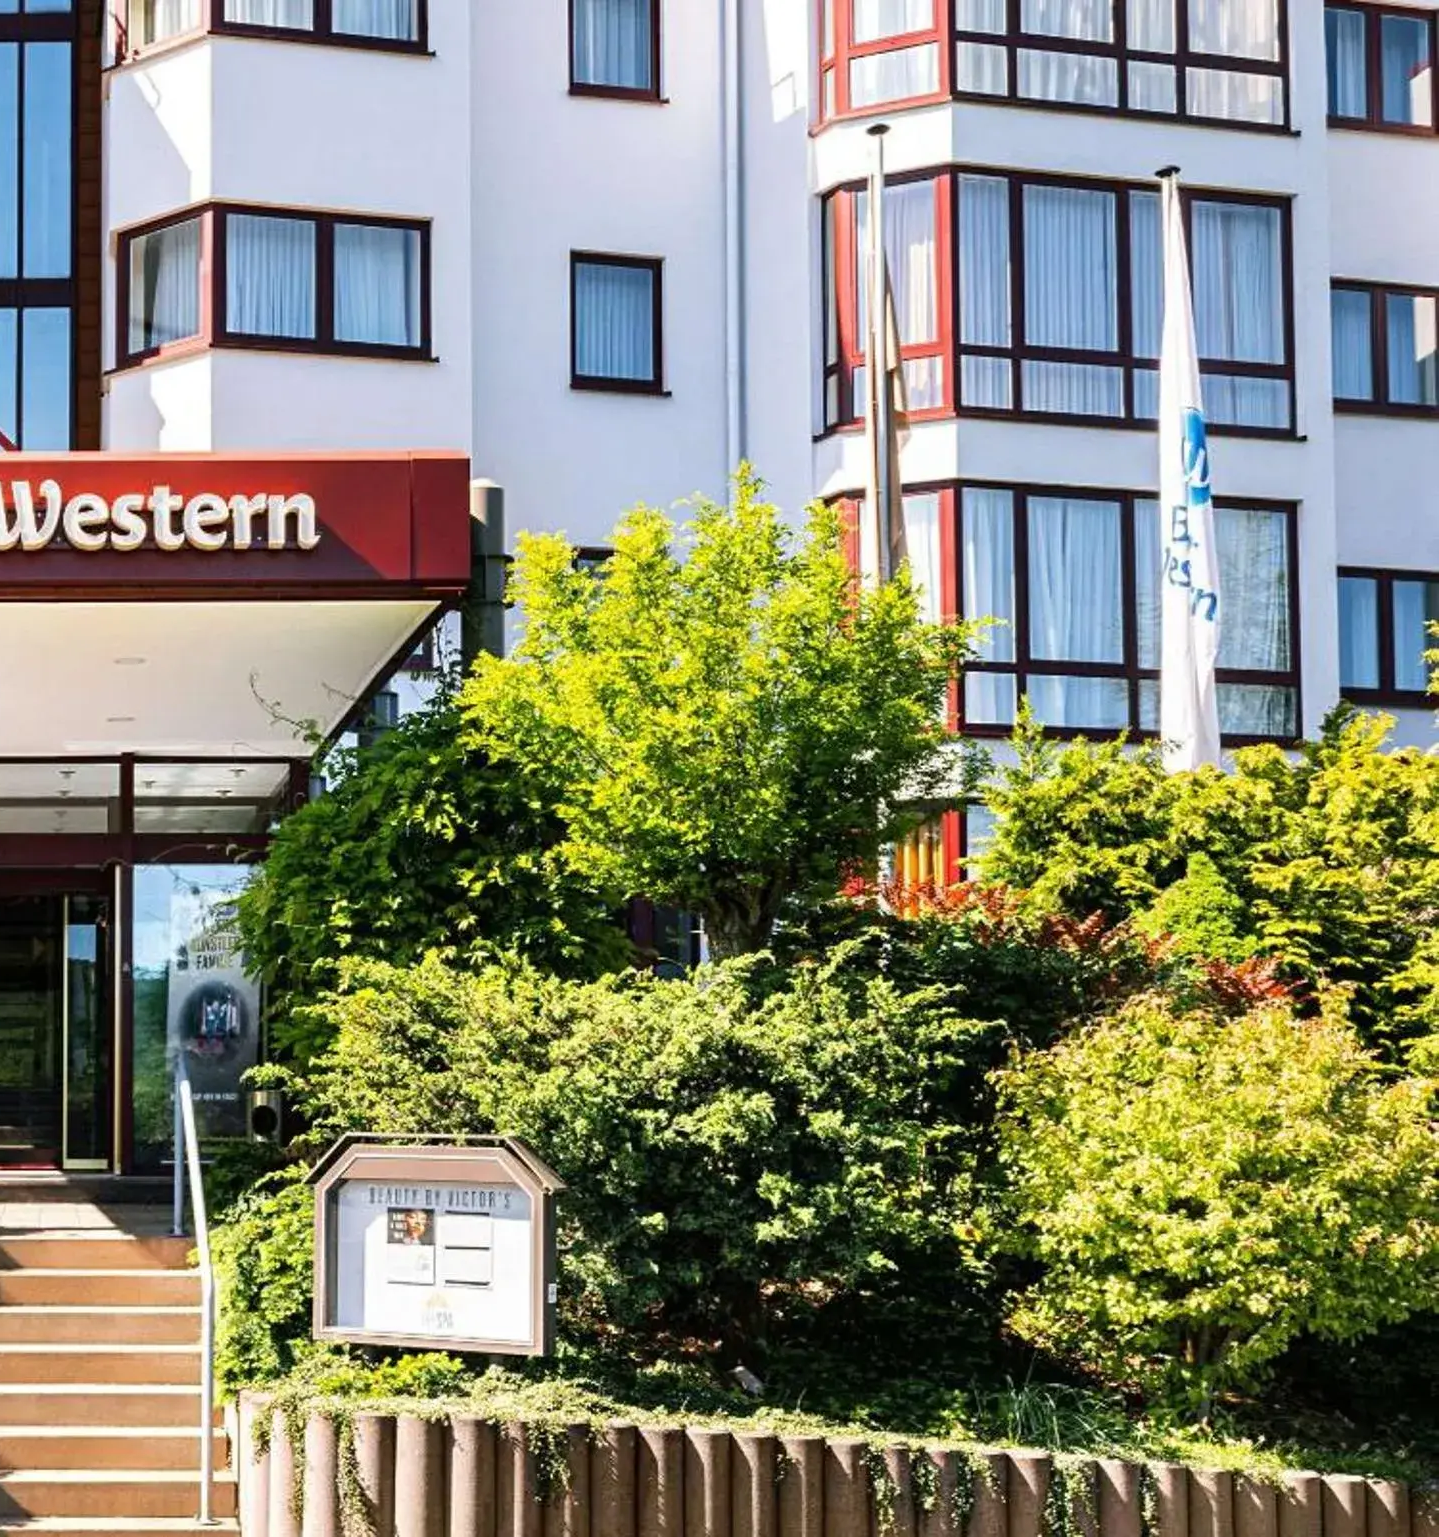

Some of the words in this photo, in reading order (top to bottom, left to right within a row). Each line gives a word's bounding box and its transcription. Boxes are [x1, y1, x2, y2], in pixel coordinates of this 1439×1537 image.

[368, 1186, 417, 1205] BEAUTY
[425, 1188, 441, 1207] BY
[447, 1189, 512, 1209] VICTOR'S
